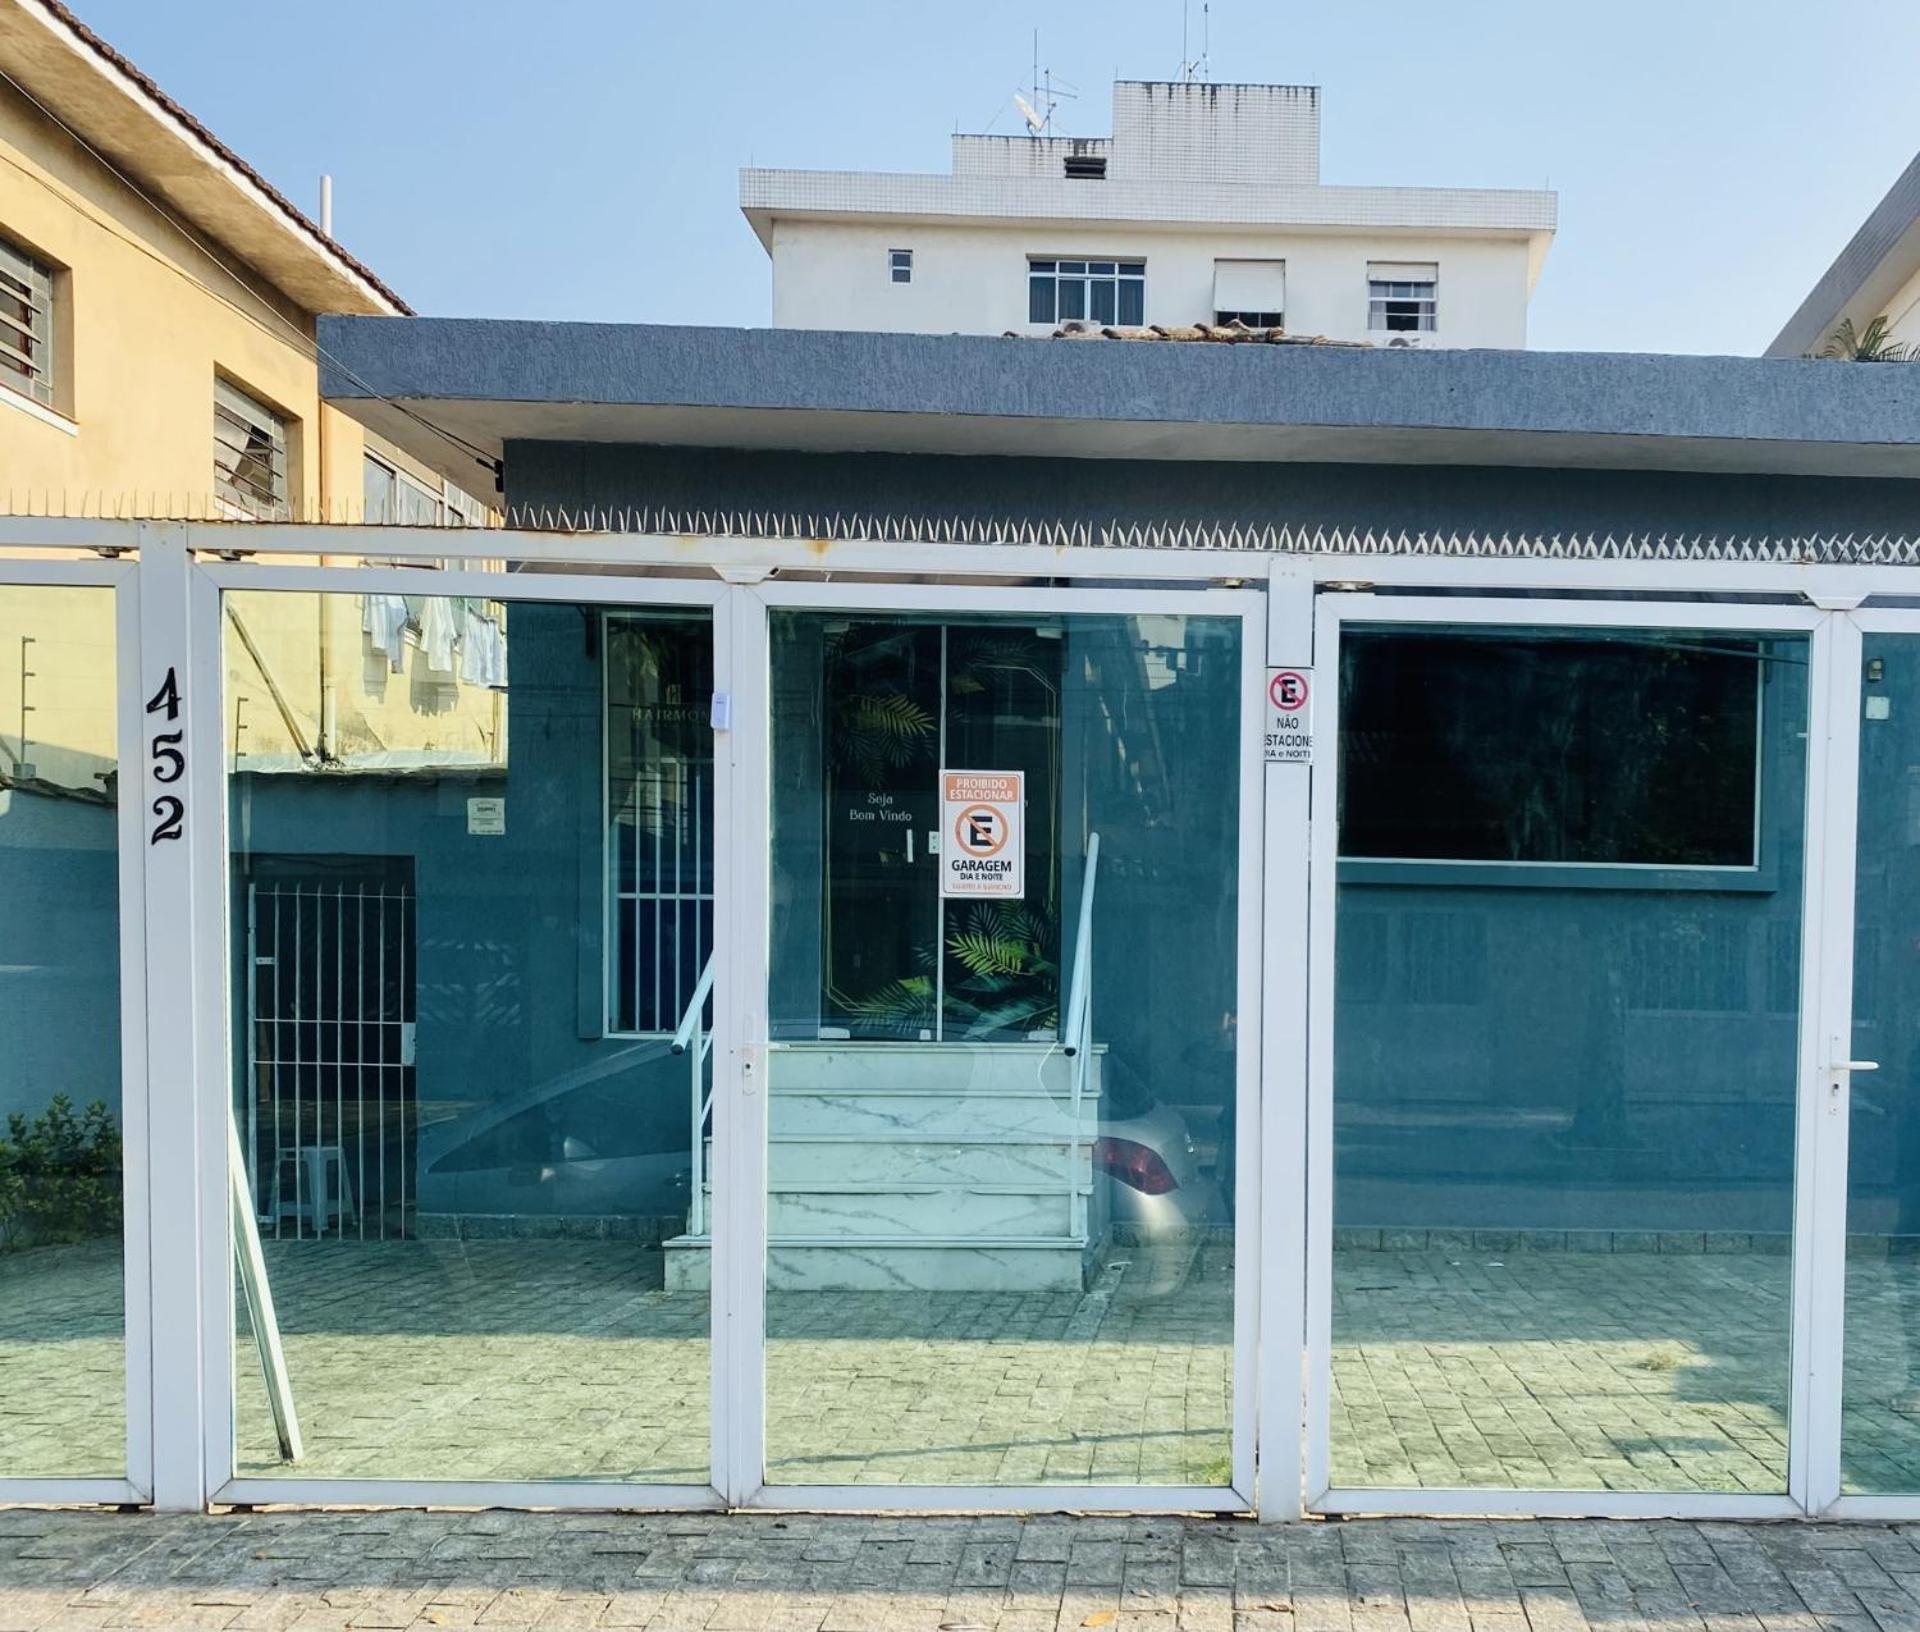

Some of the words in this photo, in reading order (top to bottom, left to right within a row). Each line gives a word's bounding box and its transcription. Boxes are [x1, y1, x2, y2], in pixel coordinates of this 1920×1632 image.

[1276, 714, 1299, 729] NÃO
[146, 667, 185, 846] 452
[956, 778, 1008, 788] PROIBIDO
[868, 792, 893, 807] Seja
[950, 789, 1013, 800] ESTACIONAR
[849, 809, 875, 820] Bom
[879, 809, 912, 821] Vindo
[952, 860, 1012, 873] GARAGEM
[960, 872, 974, 880] DIA
[982, 872, 1003, 881] NOITE
